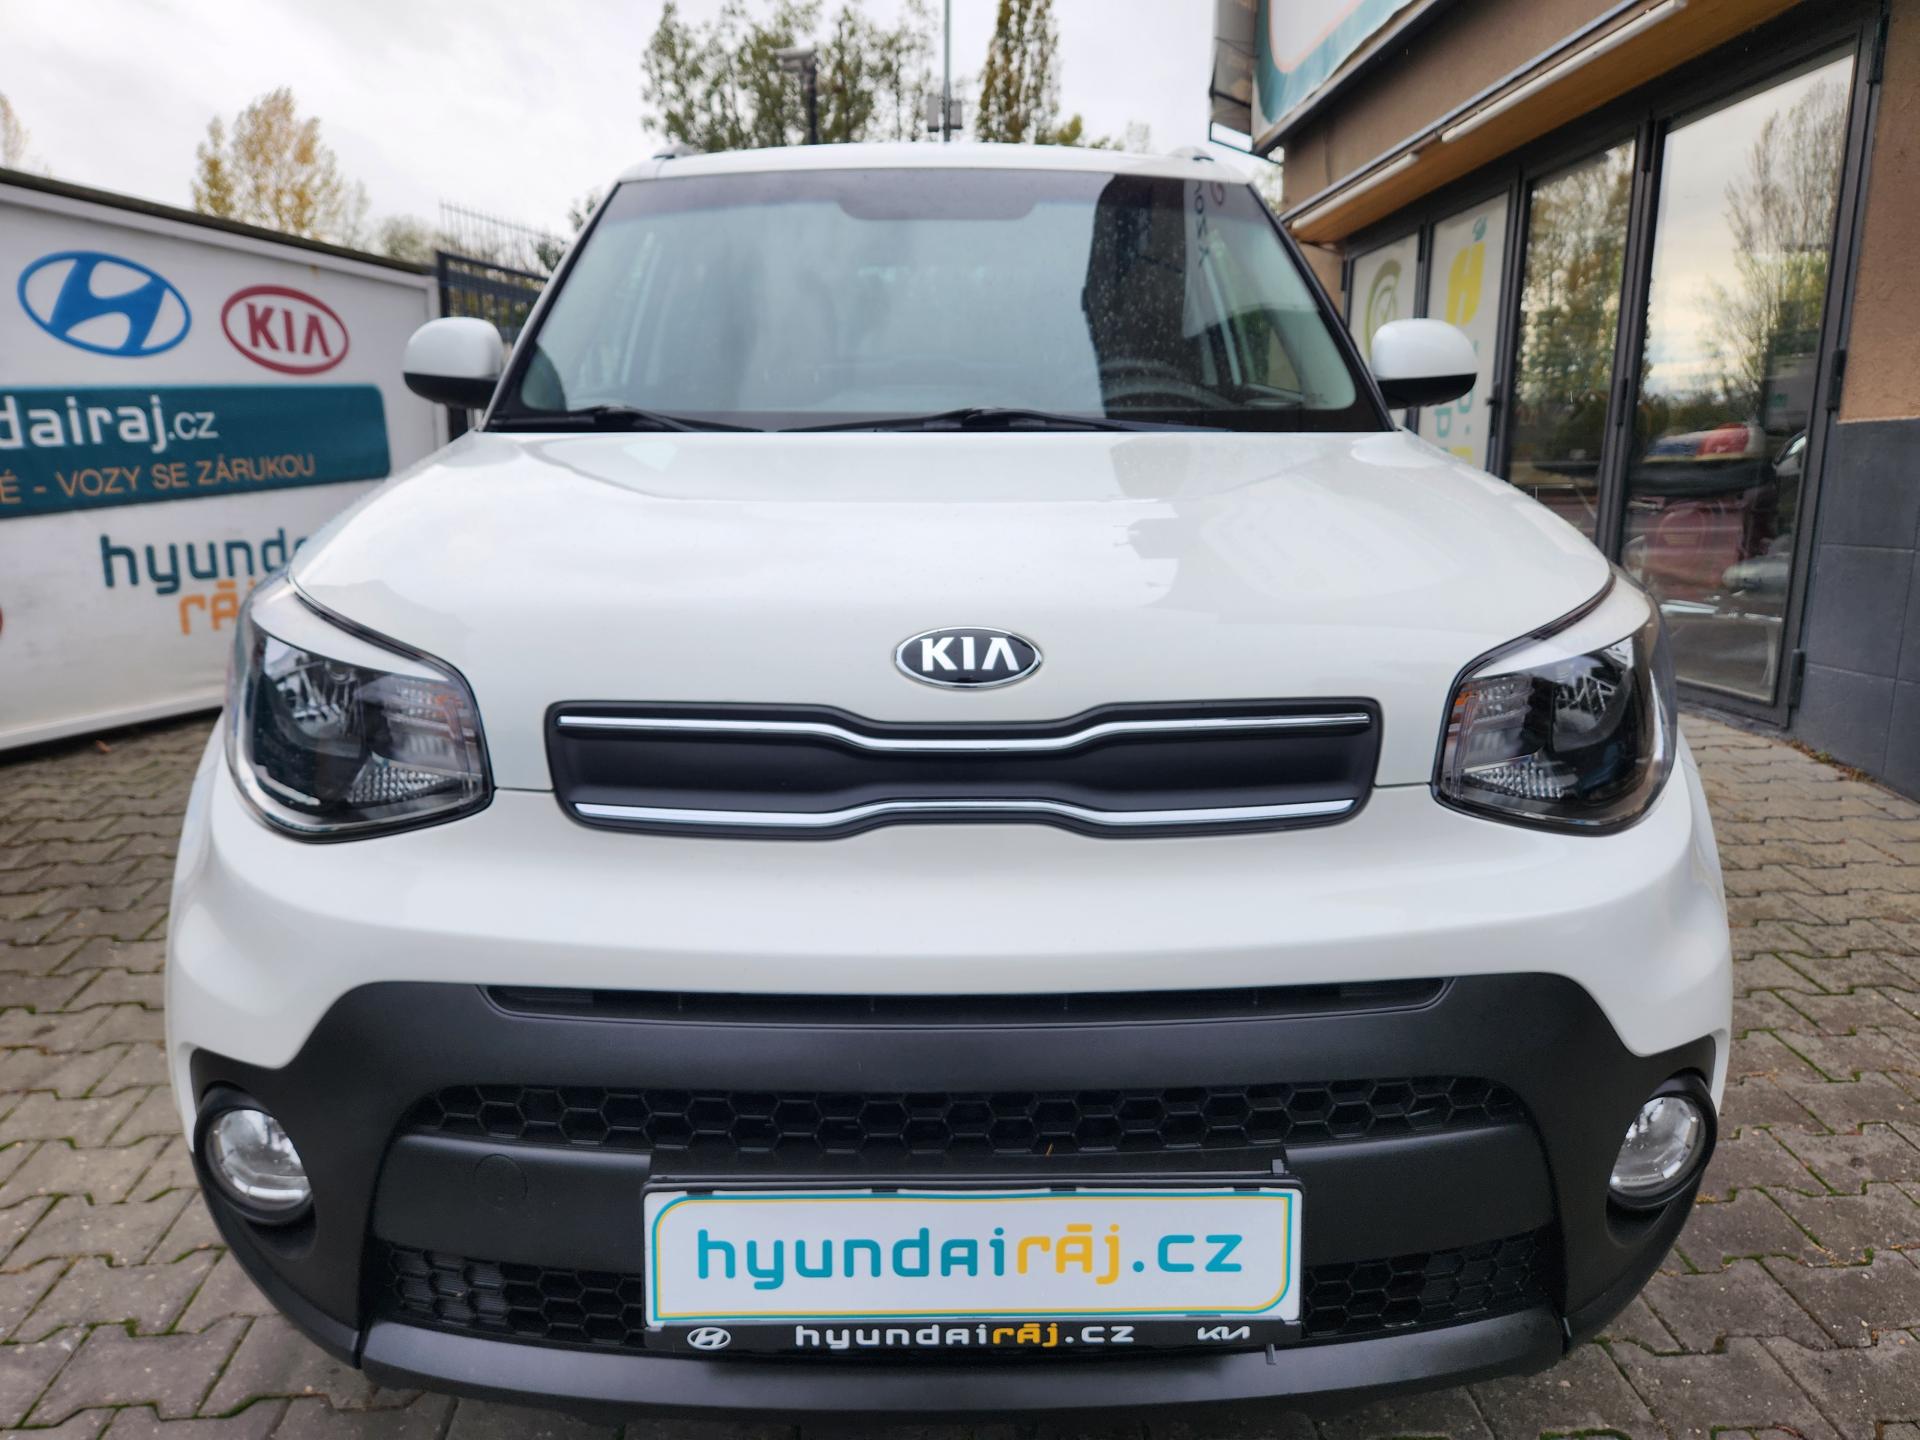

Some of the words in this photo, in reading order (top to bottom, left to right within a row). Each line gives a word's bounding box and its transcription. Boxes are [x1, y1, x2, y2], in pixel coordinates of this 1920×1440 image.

[246, 302, 331, 358] KIA
[56, 465, 141, 497] VOZY
[152, 462, 189, 490] SE
[196, 453, 316, 486] ZÁRUKOU
[100, 527, 308, 595] hyund
[920, 636, 1020, 672] KIA
